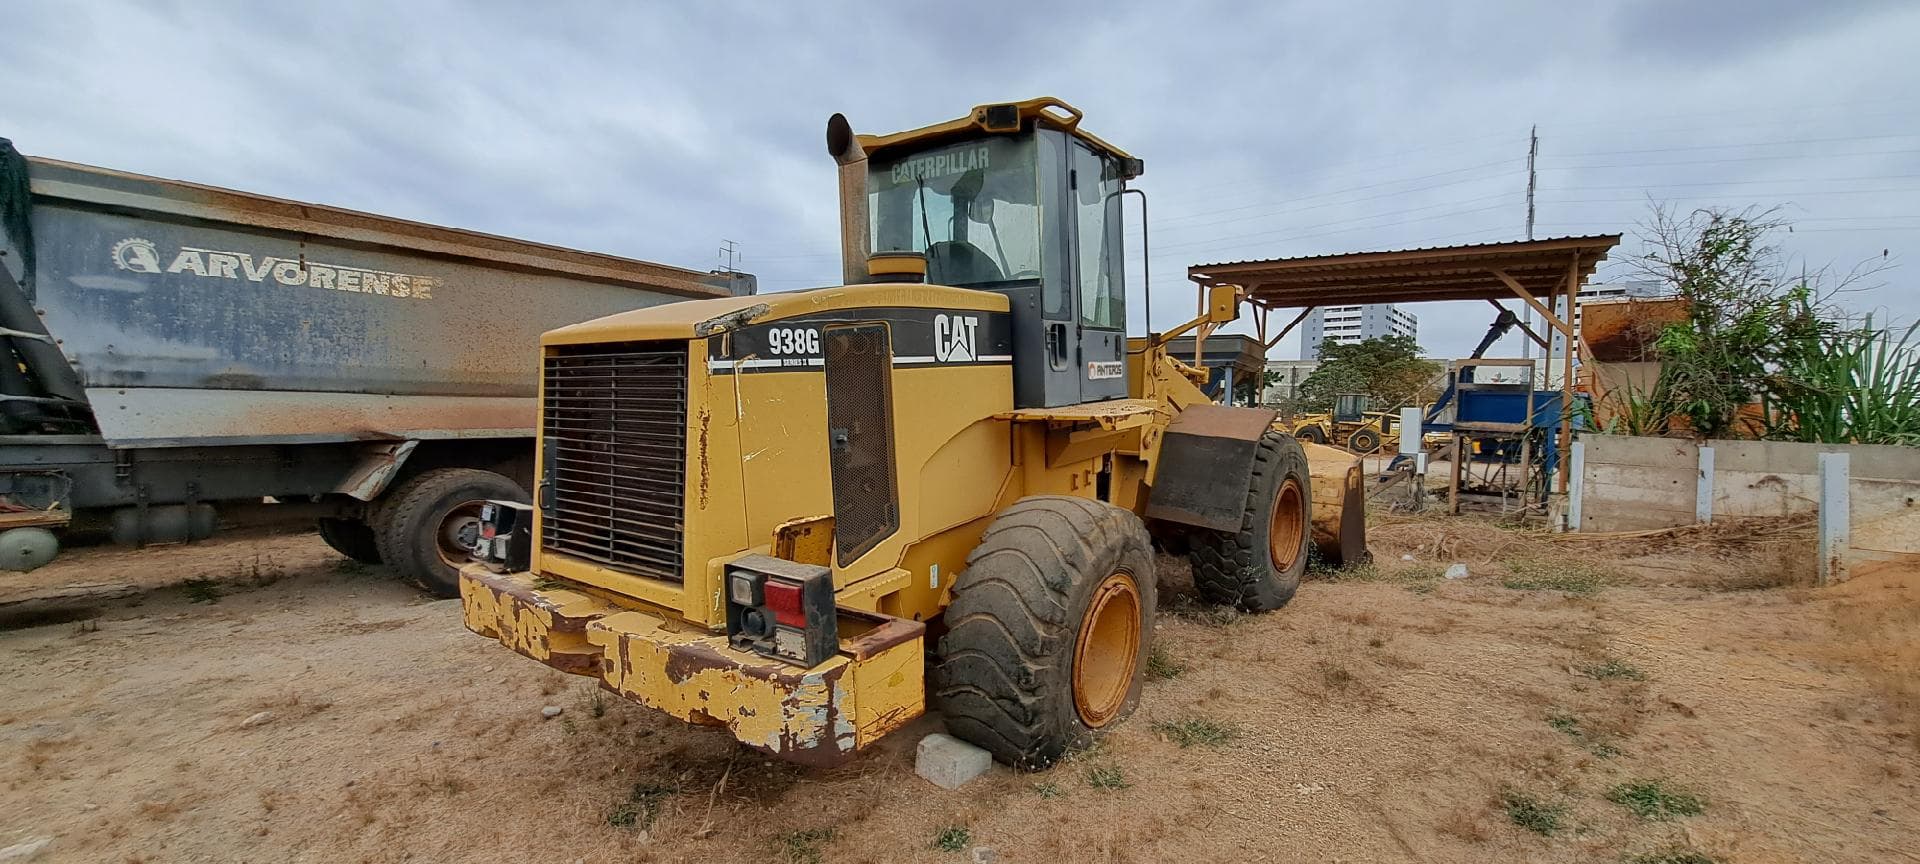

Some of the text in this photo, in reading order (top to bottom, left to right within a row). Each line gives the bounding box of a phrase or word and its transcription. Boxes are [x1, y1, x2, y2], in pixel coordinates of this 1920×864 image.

[891, 147, 989, 184] CATERPILLAR
[166, 247, 434, 299] ARVORENSE
[769, 328, 820, 355] 938G
[934, 314, 978, 362] CAT
